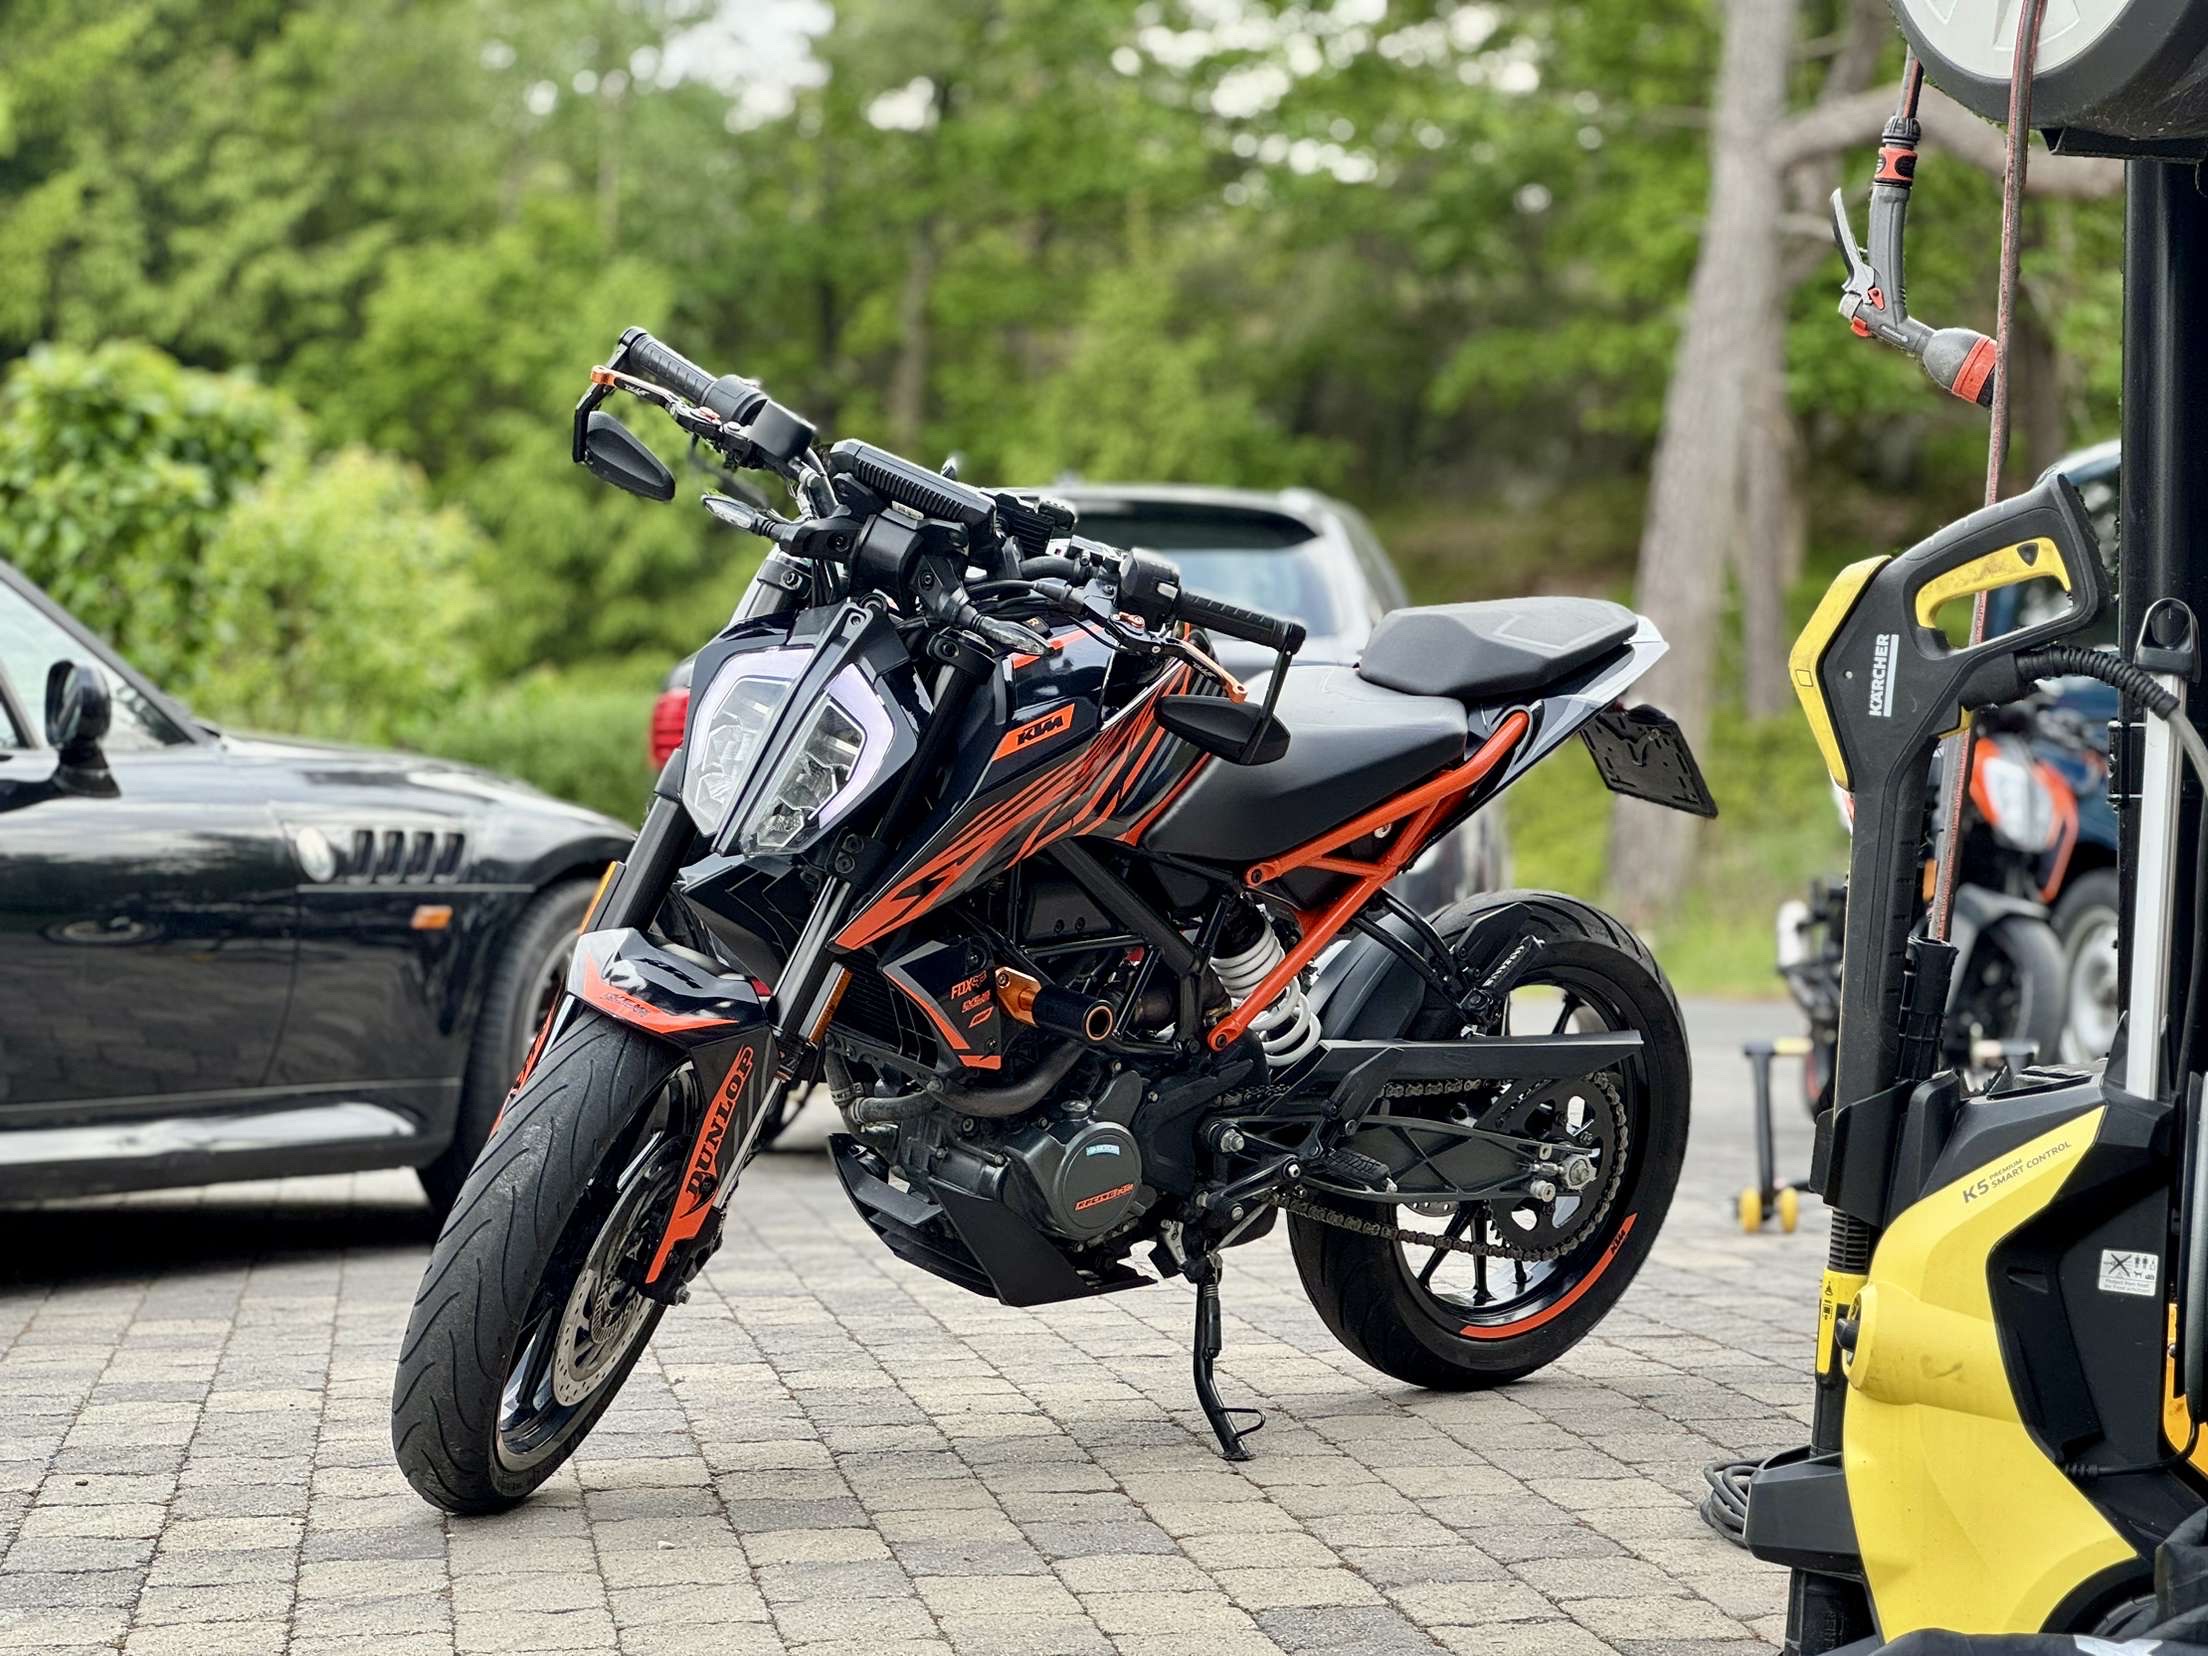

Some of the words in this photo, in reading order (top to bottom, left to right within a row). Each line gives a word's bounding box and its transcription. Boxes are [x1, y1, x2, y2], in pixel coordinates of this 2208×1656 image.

[1869, 633, 1890, 716] KÄRCHER
[1017, 715, 1063, 746] KTM
[686, 1048, 753, 1200] DUNLOP
[1989, 1158, 2023, 1180] PREMIUM
[1991, 1166, 2024, 1189] SMART
[2026, 1141, 2072, 1169] CONTROL
[1962, 1178, 1990, 1203] K5
